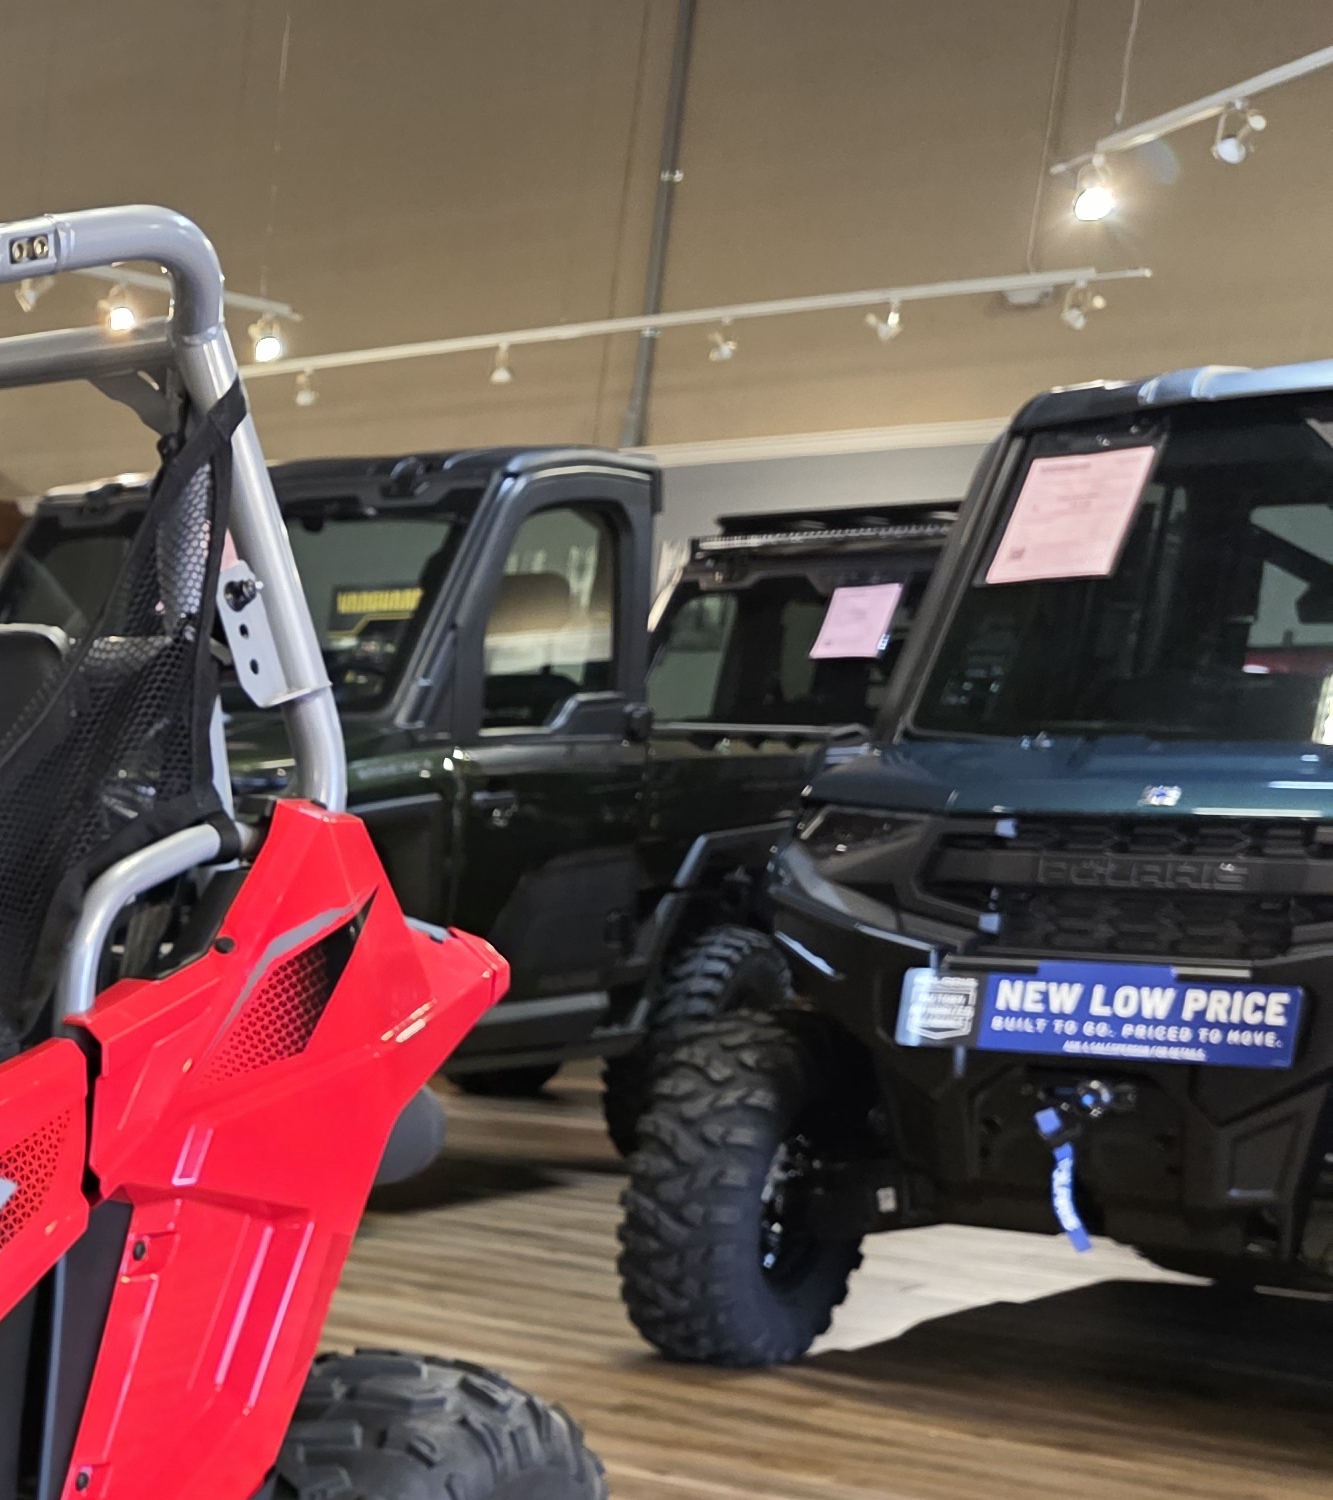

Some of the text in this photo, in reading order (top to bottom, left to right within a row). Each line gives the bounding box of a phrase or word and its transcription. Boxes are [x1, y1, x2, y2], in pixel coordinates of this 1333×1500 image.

[1036, 855, 1250, 892] POLARIS
[996, 979, 1291, 1027] NEW LOW PRICE
[990, 1015, 1047, 1034] BUILT
[1053, 1018, 1077, 1036] TO
[1120, 1023, 1193, 1044] PRICED
[1198, 1027, 1222, 1045] TO
